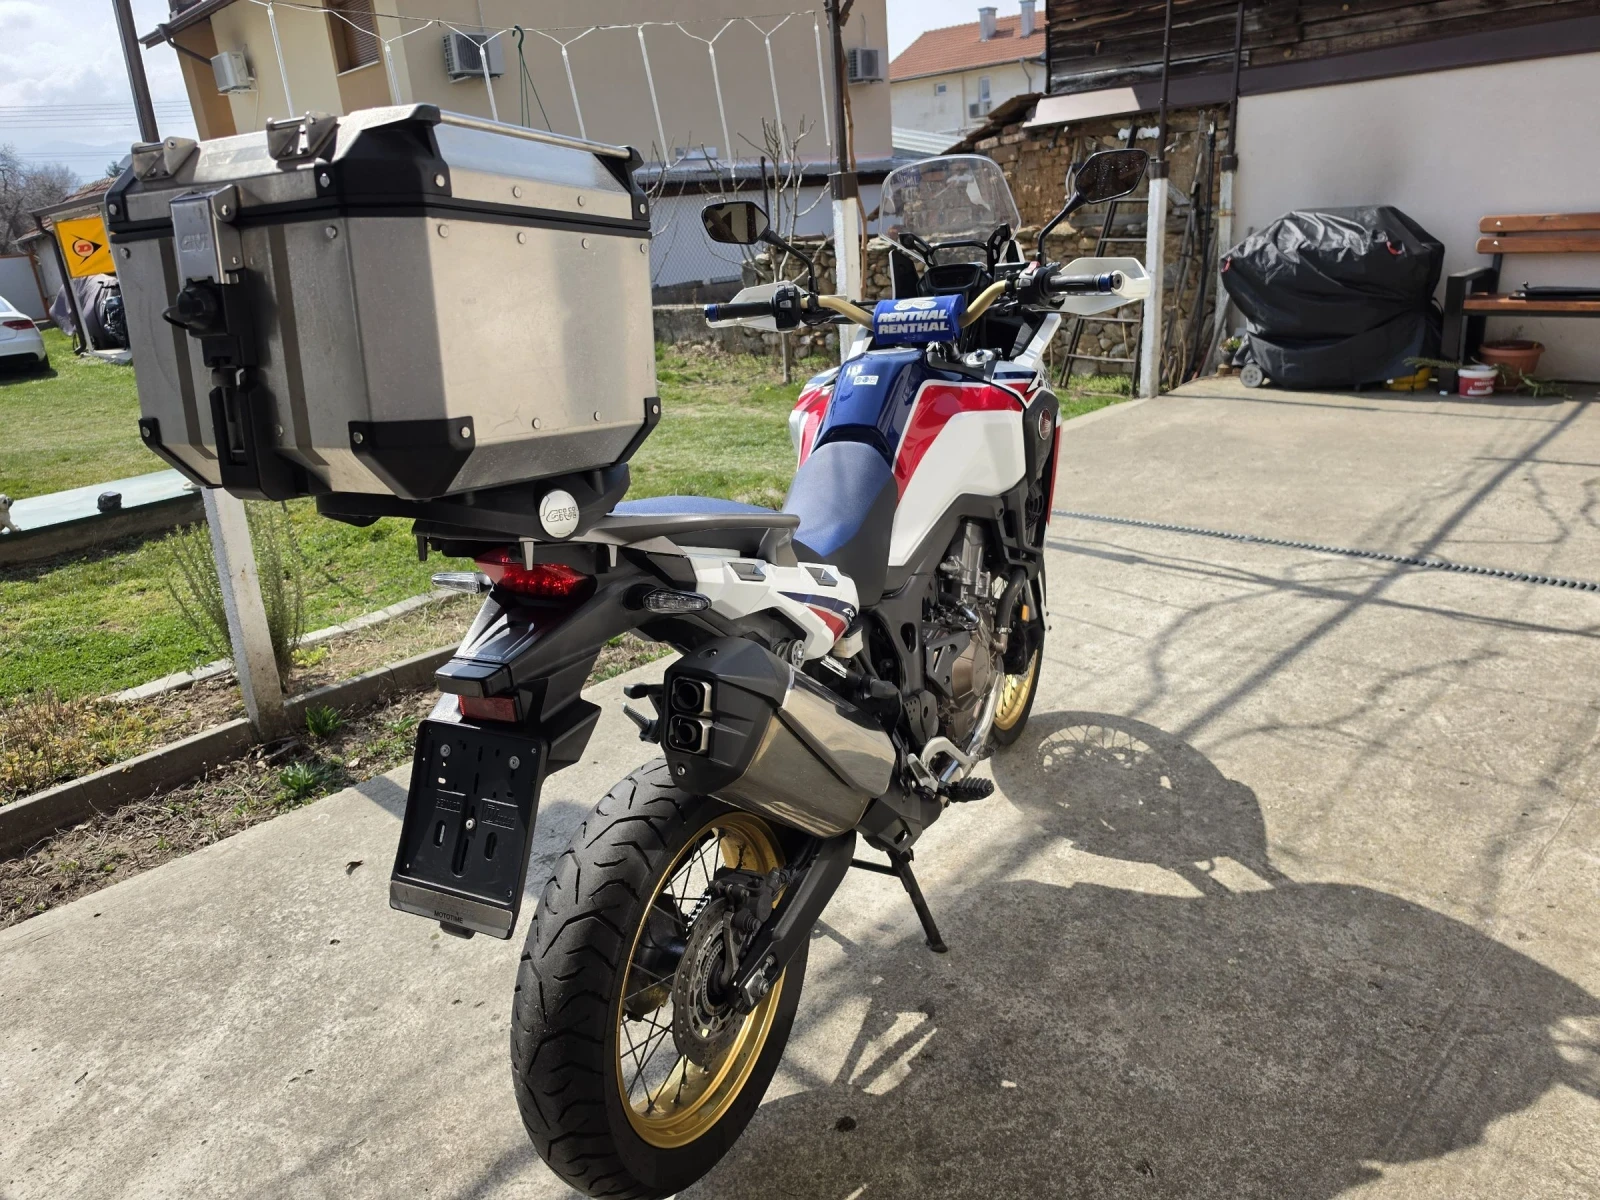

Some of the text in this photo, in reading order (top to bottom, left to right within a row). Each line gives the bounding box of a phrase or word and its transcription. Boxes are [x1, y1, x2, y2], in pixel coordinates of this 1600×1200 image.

[877, 309, 949, 323] RENTHAL
[878, 321, 949, 335] RENTHAL
[434, 910, 464, 924] MOTOTIME
